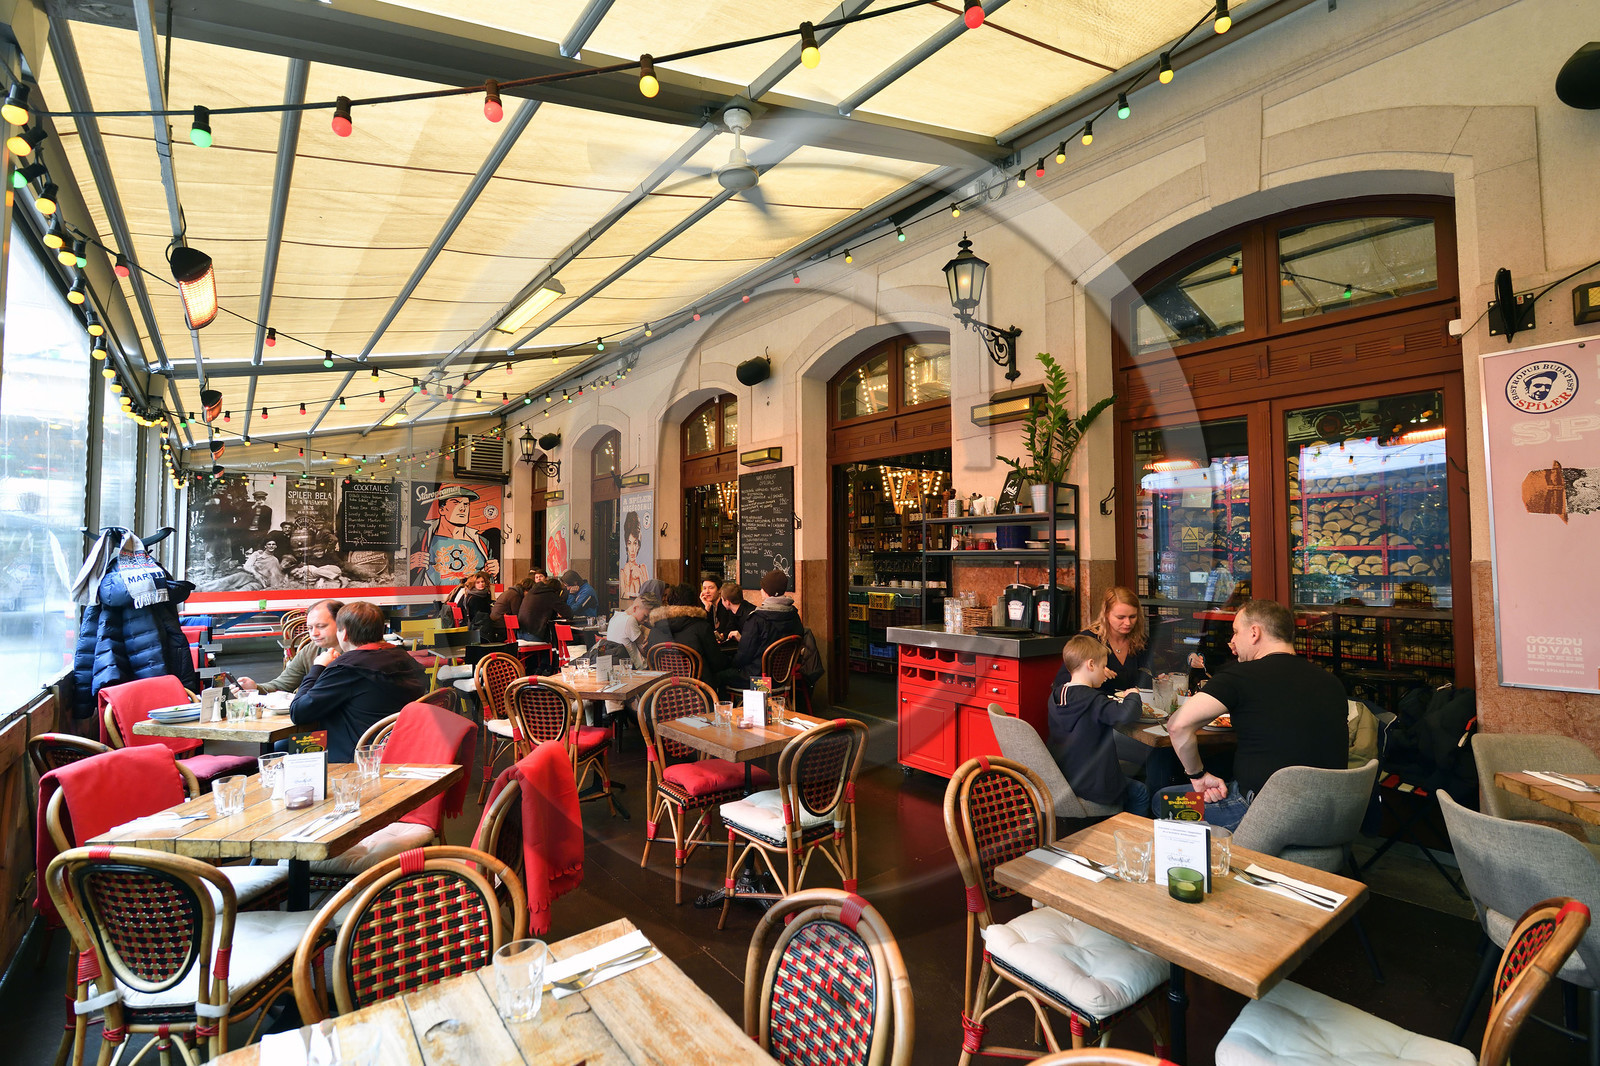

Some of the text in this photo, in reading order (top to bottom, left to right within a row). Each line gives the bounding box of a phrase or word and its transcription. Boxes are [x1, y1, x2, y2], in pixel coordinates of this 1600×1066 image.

[1511, 365, 1540, 401] BISTROPUB
[1543, 364, 1574, 392] BUDAPEST
[1516, 392, 1572, 411] SPÍLER
[353, 484, 390, 494] COCKTAILS
[416, 485, 462, 506] Staropramen
[449, 549, 465, 571] S
[1527, 635, 1583, 646] GOZSDU
[1527, 645, 1583, 656] UDVAR
